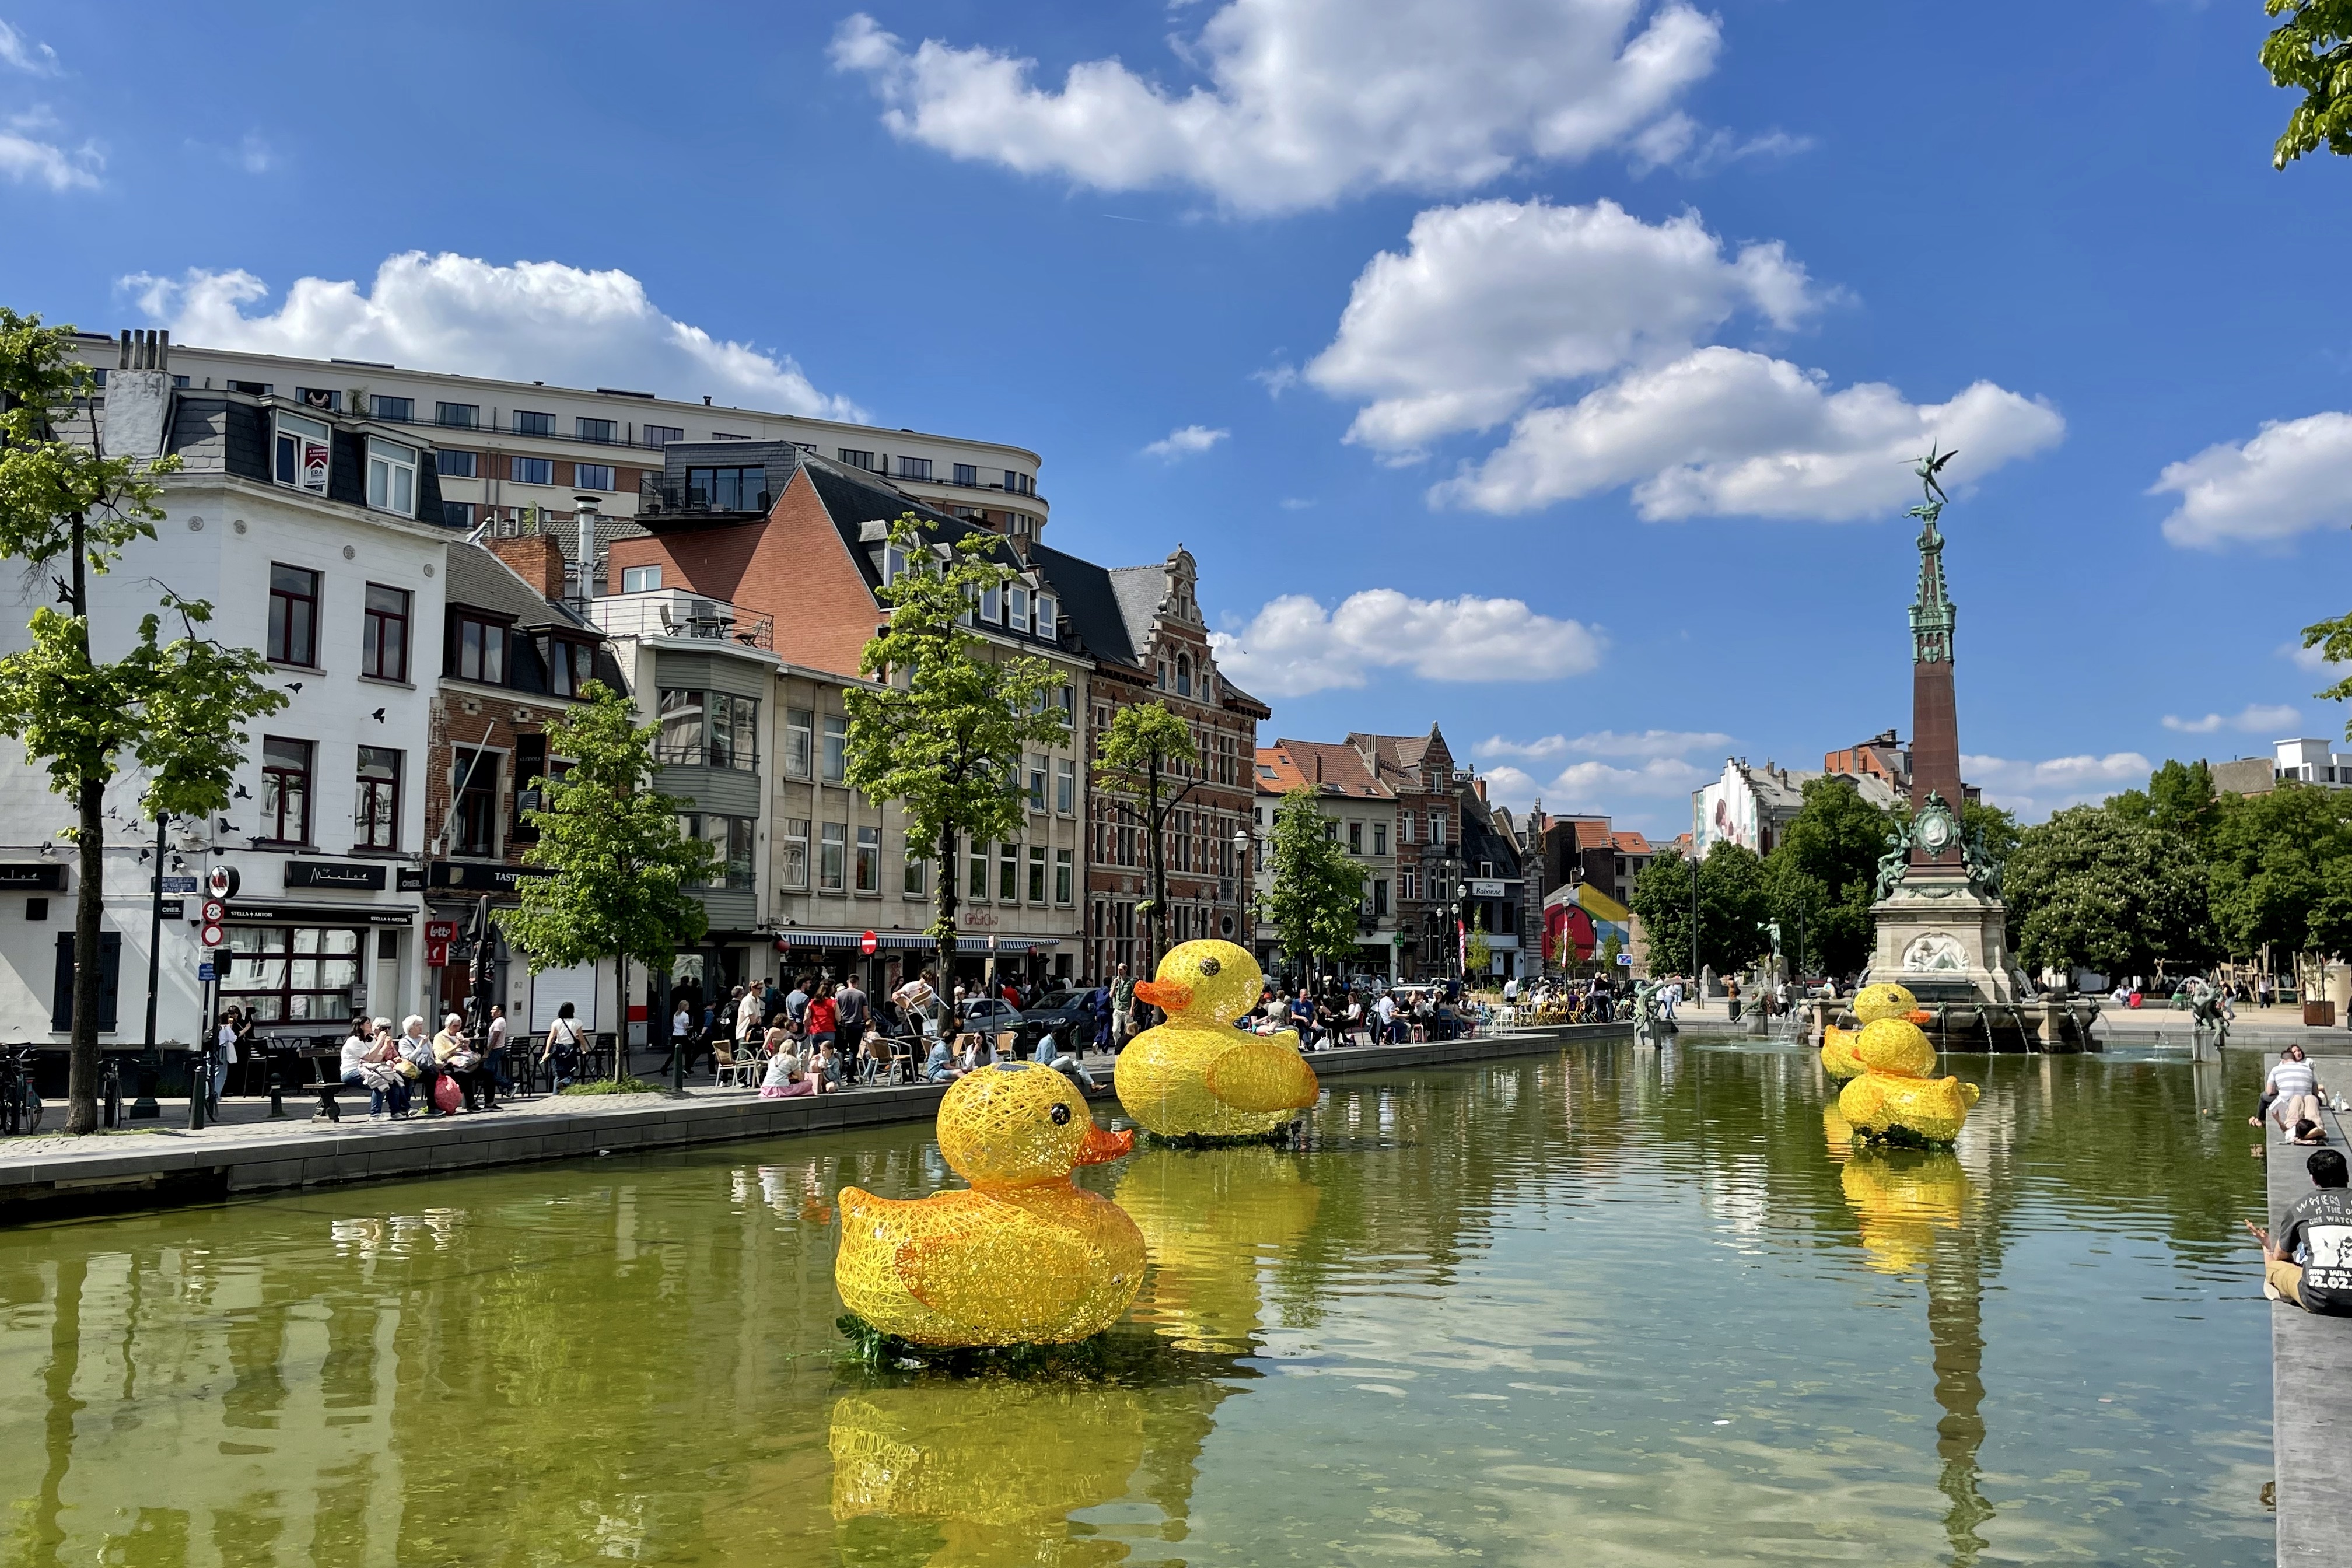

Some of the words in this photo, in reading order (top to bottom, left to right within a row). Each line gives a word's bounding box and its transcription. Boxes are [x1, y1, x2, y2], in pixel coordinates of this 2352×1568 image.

[209, 907, 215, 916] 2
[2296, 1195, 2341, 1214] WHEN
[2315, 1206, 2322, 1215] IS
[2325, 1205, 2342, 1214] THE
